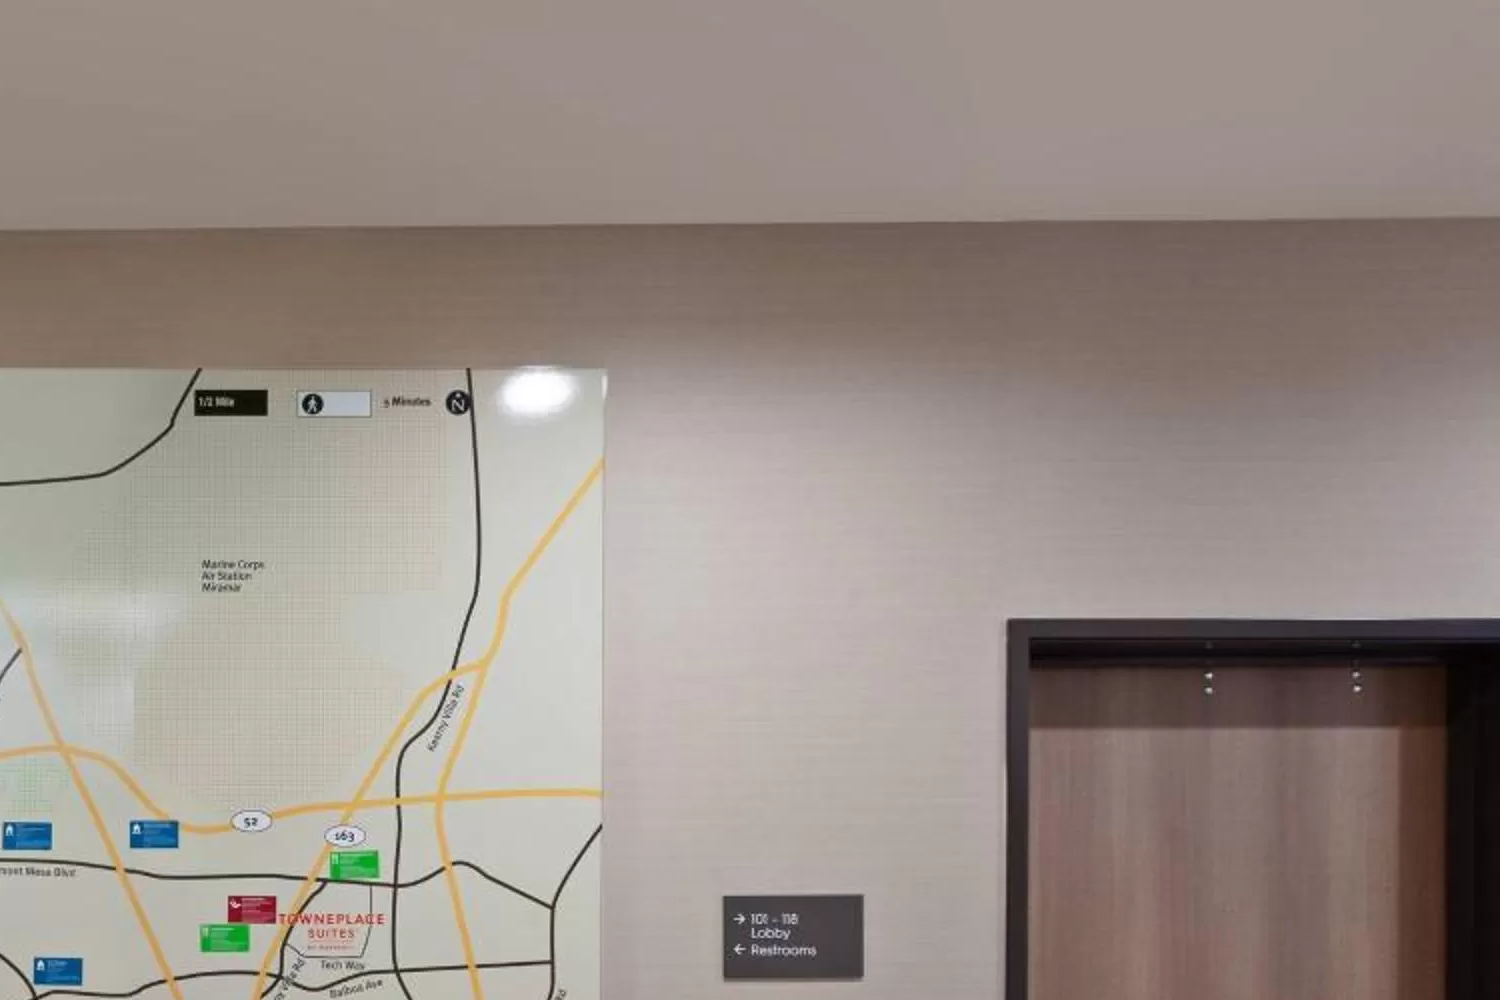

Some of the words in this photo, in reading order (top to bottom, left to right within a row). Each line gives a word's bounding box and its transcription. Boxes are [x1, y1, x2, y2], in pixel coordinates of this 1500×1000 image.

[391, 397, 432, 407] Minutes
[201, 559, 236, 569] Marine
[237, 559, 264, 571] Corps
[201, 571, 215, 581] Air
[218, 571, 252, 581] Station
[243, 816, 258, 827] 52
[334, 830, 355, 843] 163
[278, 913, 386, 926] TOWNEPLACE
[751, 913, 769, 925] 101
[781, 913, 799, 925] 118
[307, 928, 356, 939] SUITES
[751, 927, 791, 940] Lobby
[751, 944, 817, 957] Restrooms
[321, 959, 343, 970] Tech
